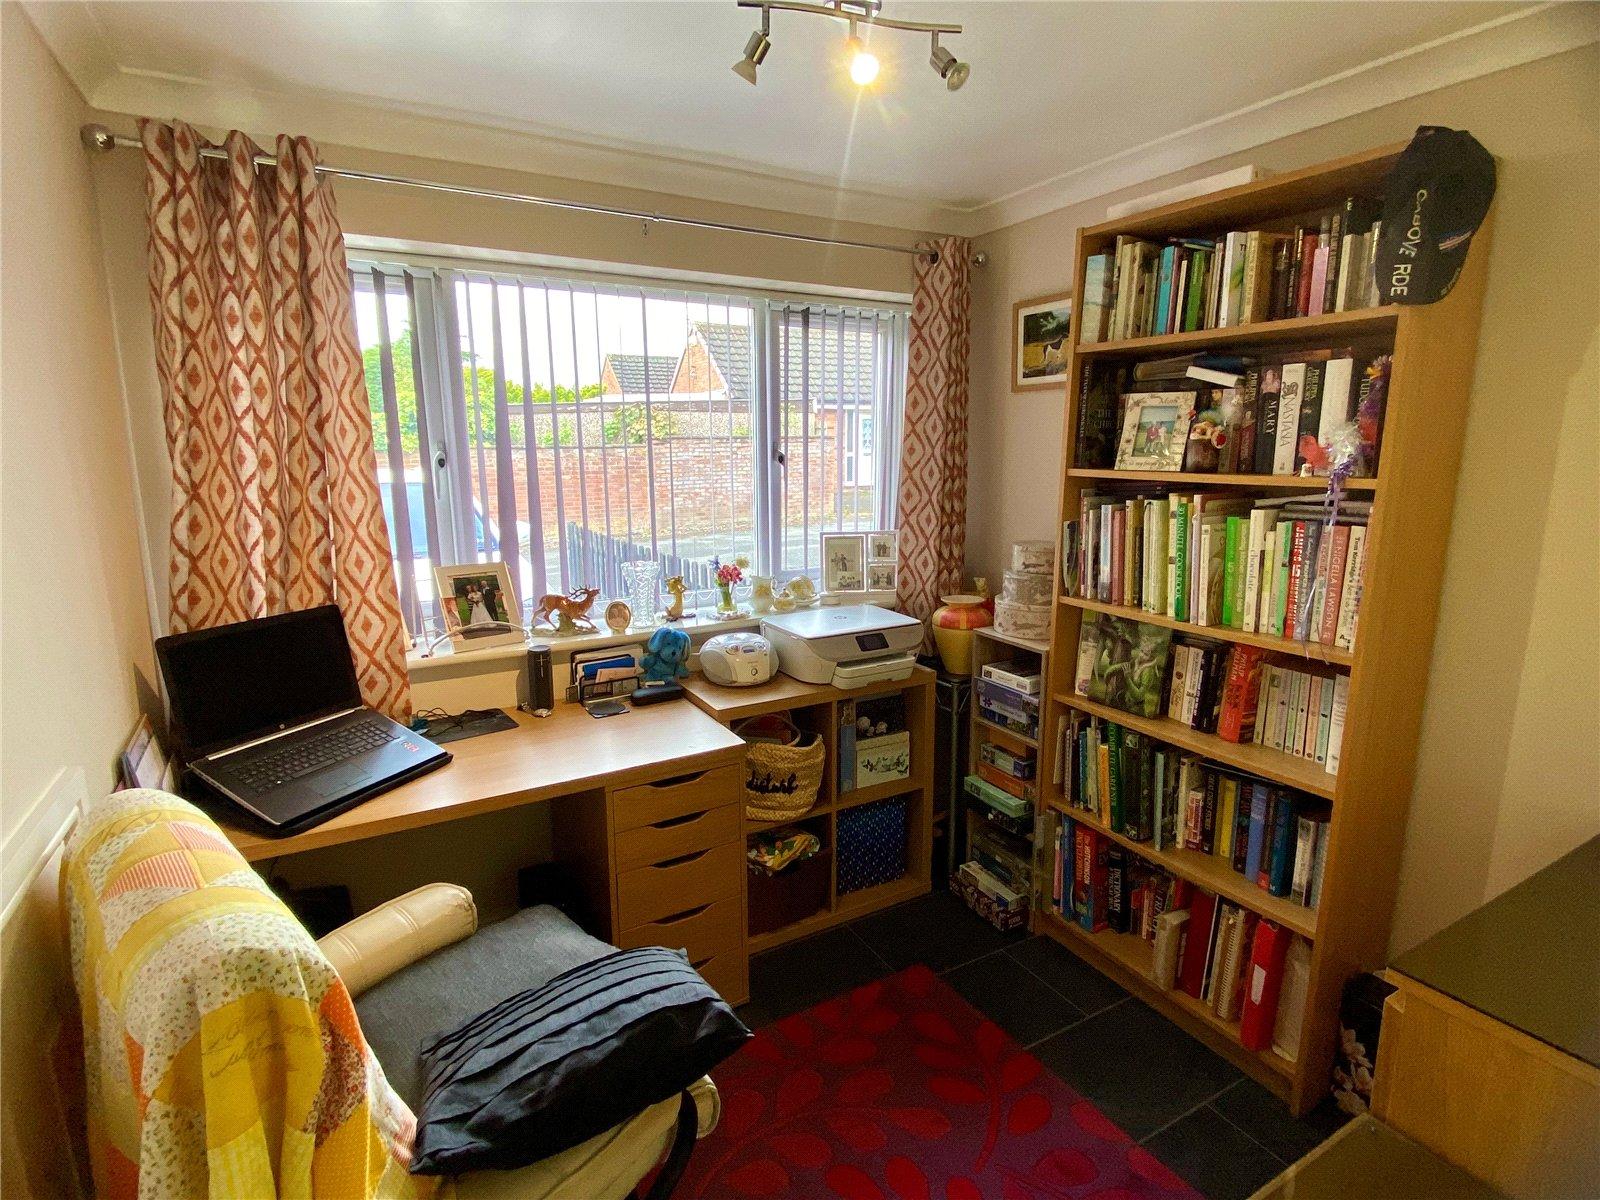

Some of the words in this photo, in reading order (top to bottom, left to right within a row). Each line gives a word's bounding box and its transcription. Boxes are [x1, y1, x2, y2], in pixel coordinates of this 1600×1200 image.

[1310, 369, 1320, 399] PHILIPPA
[1265, 399, 1278, 435] MARY
[1279, 381, 1299, 447] ANASTASIA
[1176, 516, 1185, 550] MINUTE
[1353, 537, 1362, 551] Tom
[1247, 549, 1260, 592] chocolate
[1302, 560, 1311, 587] PROPER
[1331, 546, 1343, 585] NIGELLA
[1348, 551, 1359, 584] Kerridge's
[1324, 587, 1337, 628] LAWSON
[1230, 646, 1241, 682] PULLMAN
[1239, 653, 1248, 679] PHILIP
[1109, 728, 1117, 764] COMPLETE
[1110, 766, 1118, 807] GARDENER
[1083, 845, 1092, 886] HUTCHINSON
[1111, 868, 1122, 914] DICTIONARY
